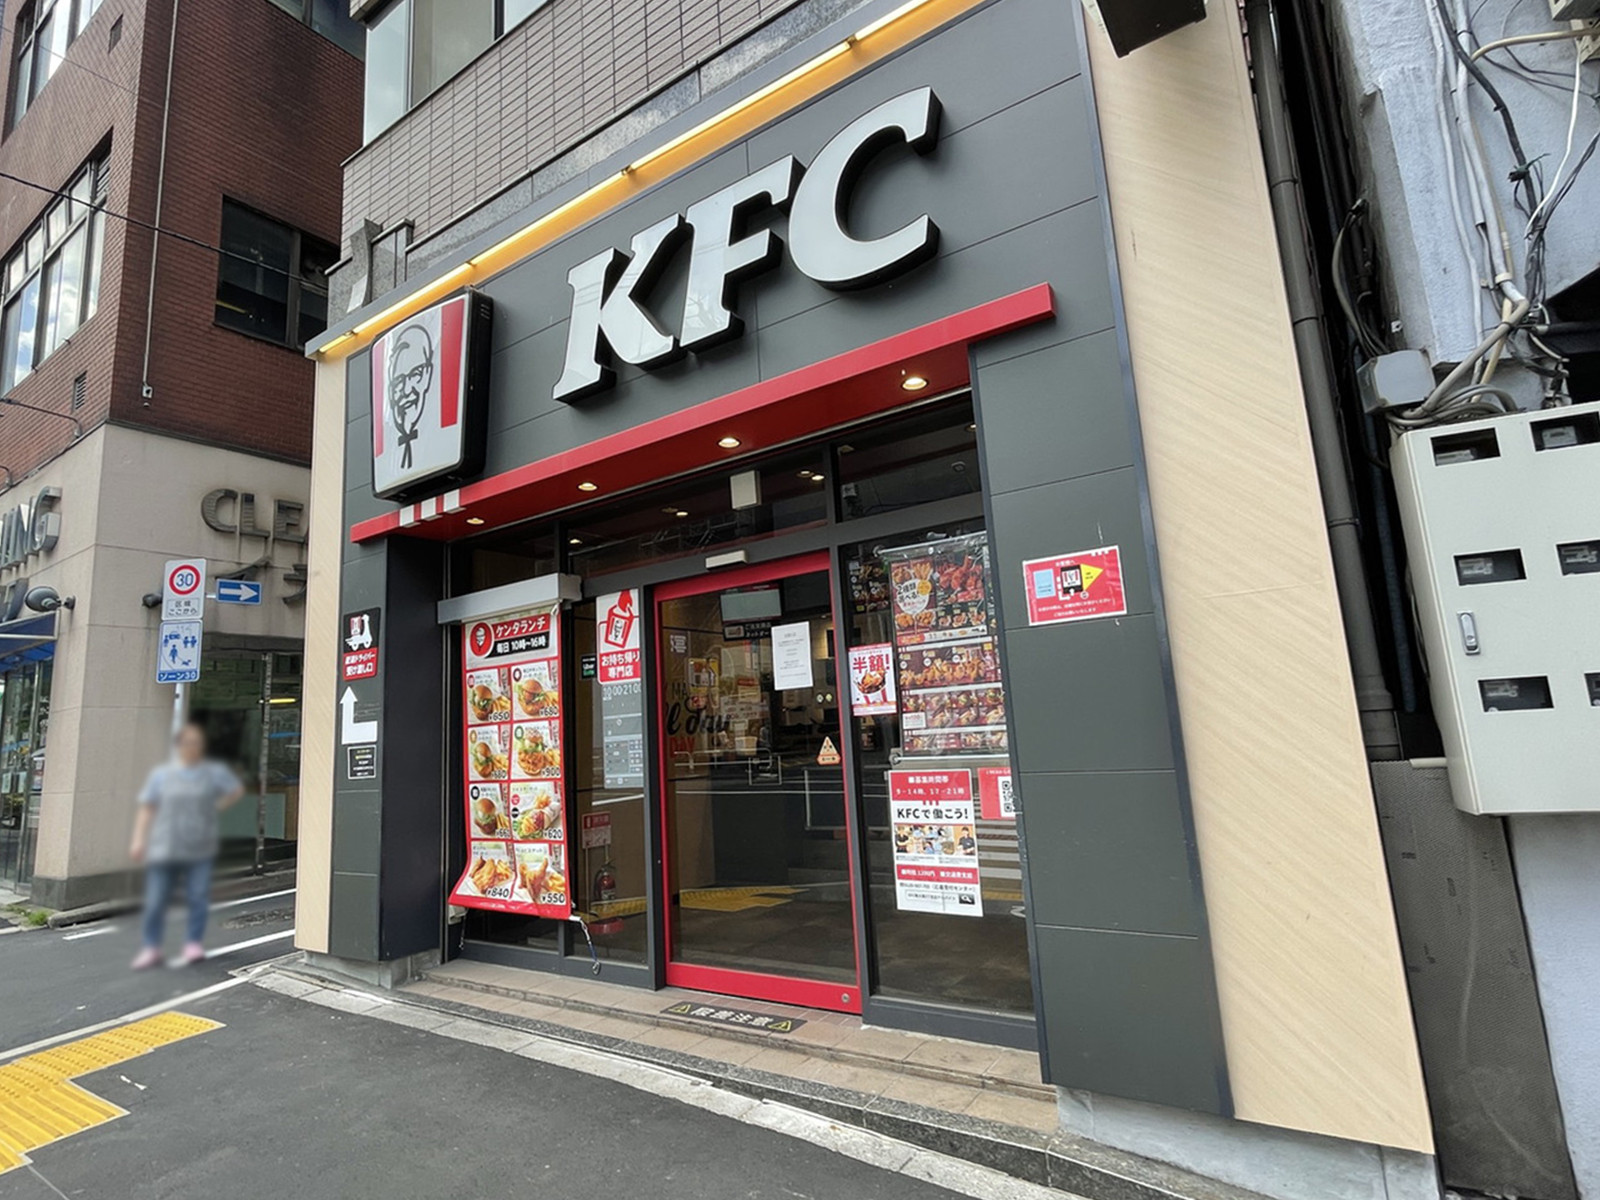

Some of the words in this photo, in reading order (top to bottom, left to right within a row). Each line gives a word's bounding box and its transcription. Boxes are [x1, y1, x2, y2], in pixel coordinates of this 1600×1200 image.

[553, 86, 936, 402] KFC
[201, 488, 308, 544] CLE
[176, 573, 194, 587] 30
[175, 600, 191, 608] 区域
[168, 608, 197, 616] ここから
[496, 616, 546, 638] ケンタランチ
[497, 642, 510, 654] 毎日
[601, 650, 640, 667] お持ち帰り
[852, 653, 890, 674] 半額!
[608, 665, 633, 679] 専門店
[488, 710, 510, 721] ¥650
[539, 706, 558, 717] ¥680
[542, 767, 560, 777] ¥900
[897, 807, 968, 820] KFCで働こう!
[544, 828, 563, 839] ¥620
[487, 887, 510, 898] ¥840
[542, 893, 566, 903] ¥550
[690, 1006, 773, 1026] 段差注意
